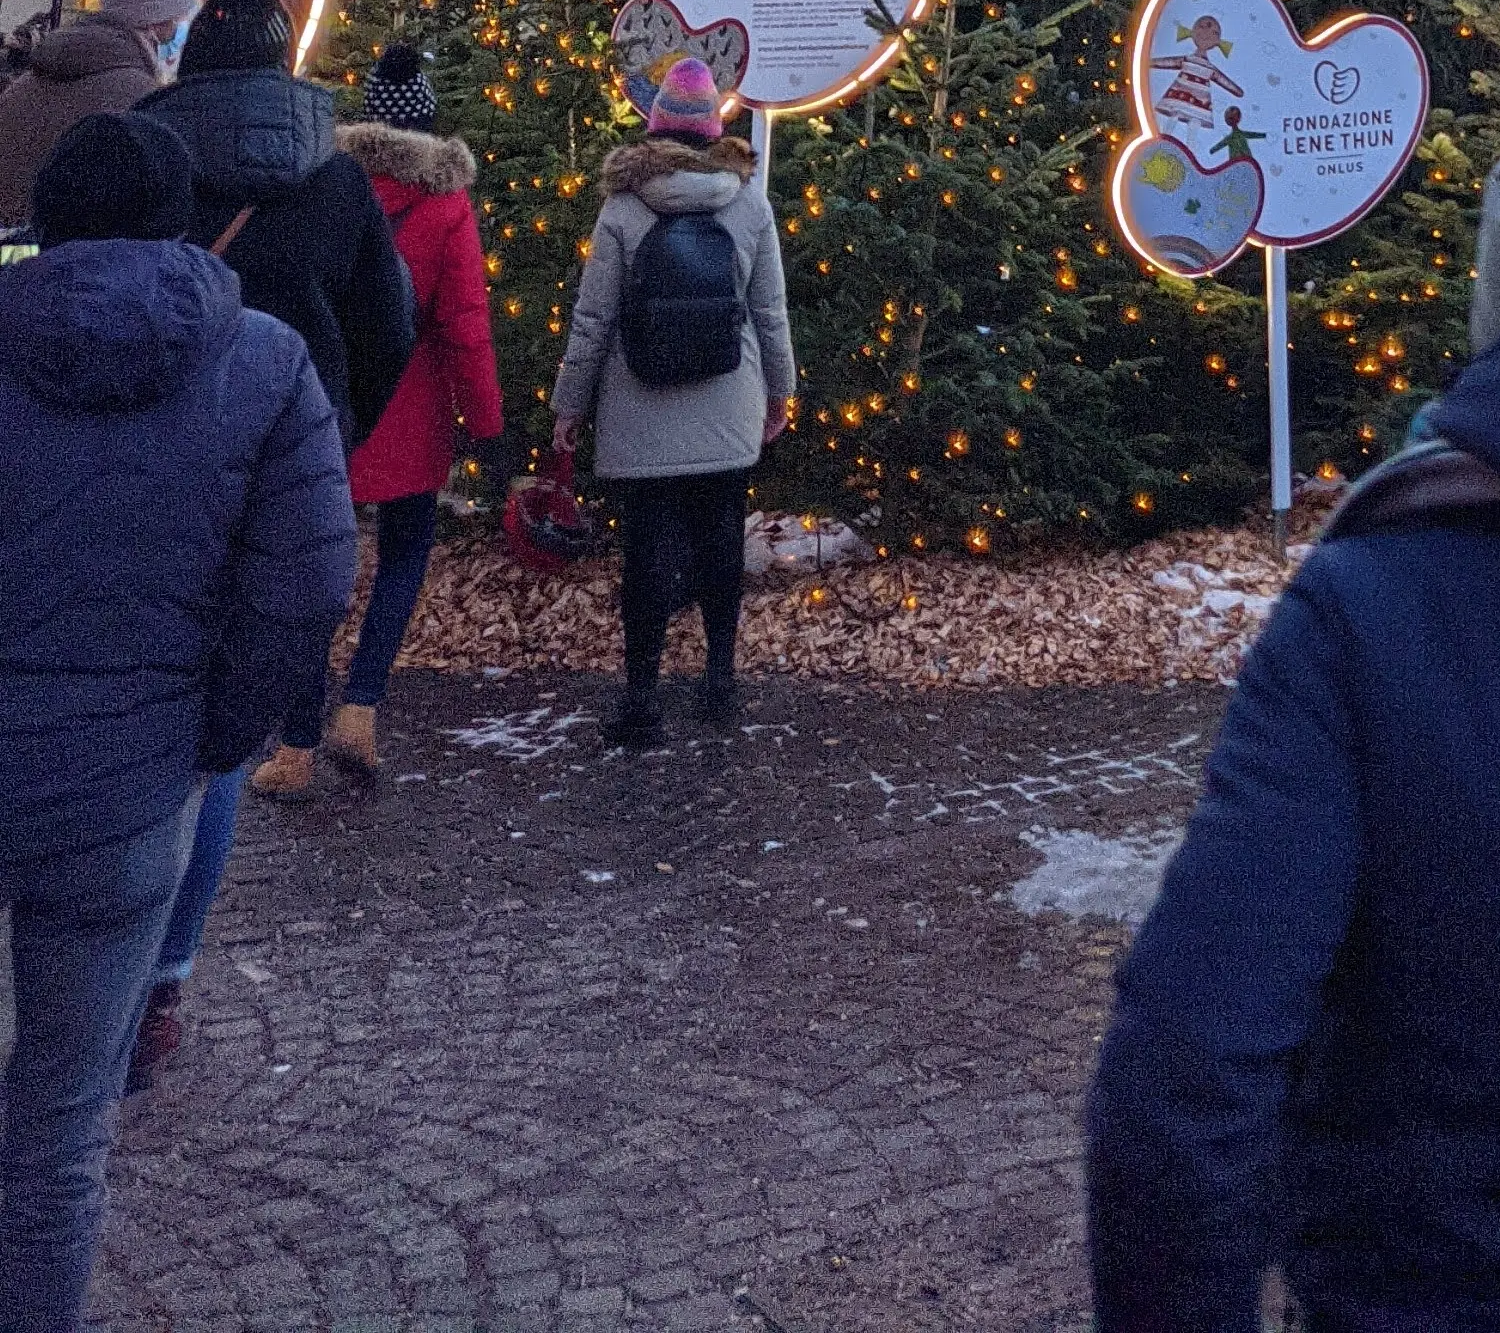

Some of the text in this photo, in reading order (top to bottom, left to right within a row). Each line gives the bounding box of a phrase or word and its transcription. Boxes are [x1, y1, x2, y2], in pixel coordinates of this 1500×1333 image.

[1283, 109, 1392, 132] FONDAZIONE
[1283, 129, 1393, 155] LENE THUN
[1316, 162, 1363, 175] ONLUS
